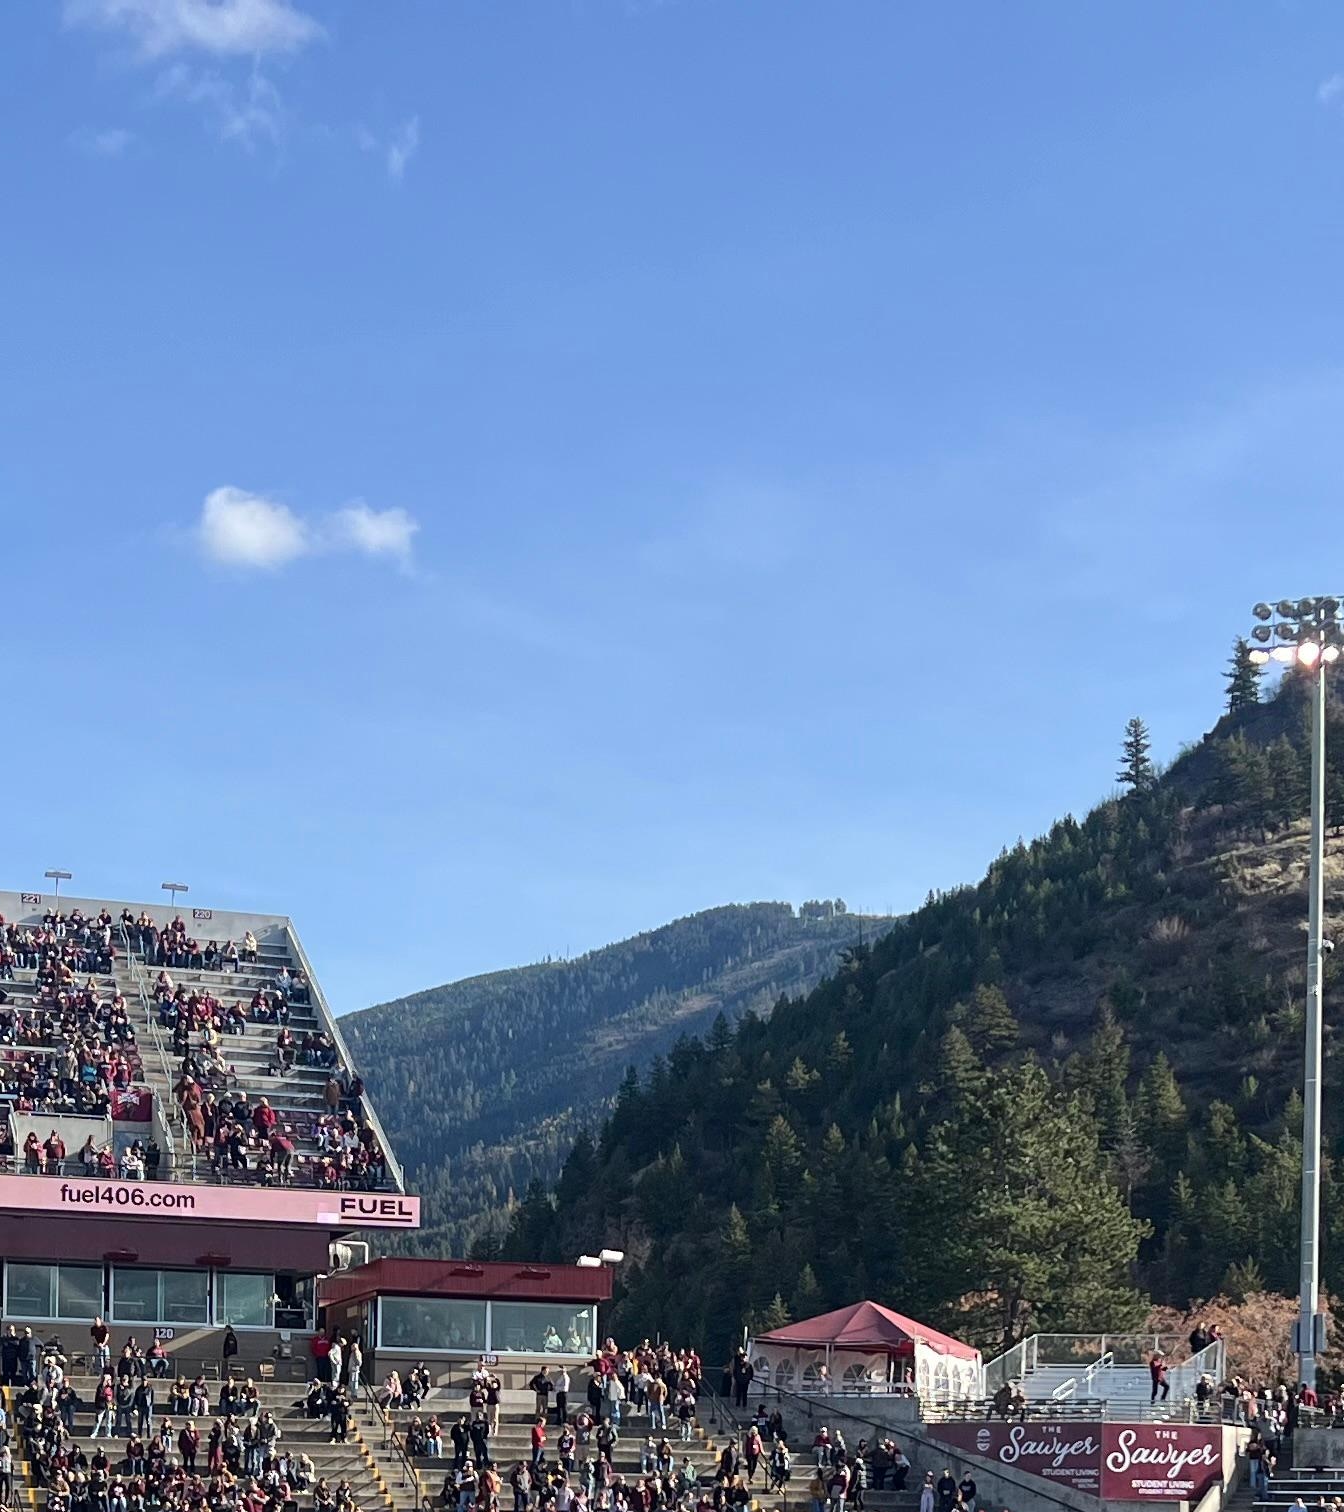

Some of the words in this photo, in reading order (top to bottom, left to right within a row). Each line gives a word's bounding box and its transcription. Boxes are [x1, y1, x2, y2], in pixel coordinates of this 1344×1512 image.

[22, 894, 40, 904] 221
[194, 910, 211, 918] 220
[61, 1184, 195, 1209] fuel406.com
[341, 1198, 412, 1216] FUEL
[156, 1328, 173, 1339] 120
[1042, 1425, 1062, 1434] THE
[1155, 1430, 1178, 1439] THE
[999, 1426, 1100, 1467] Sawyer
[1106, 1429, 1220, 1478] Sawyer
[1132, 1480, 1167, 1488] STUDENT
[1169, 1480, 1194, 1489] LIVING
